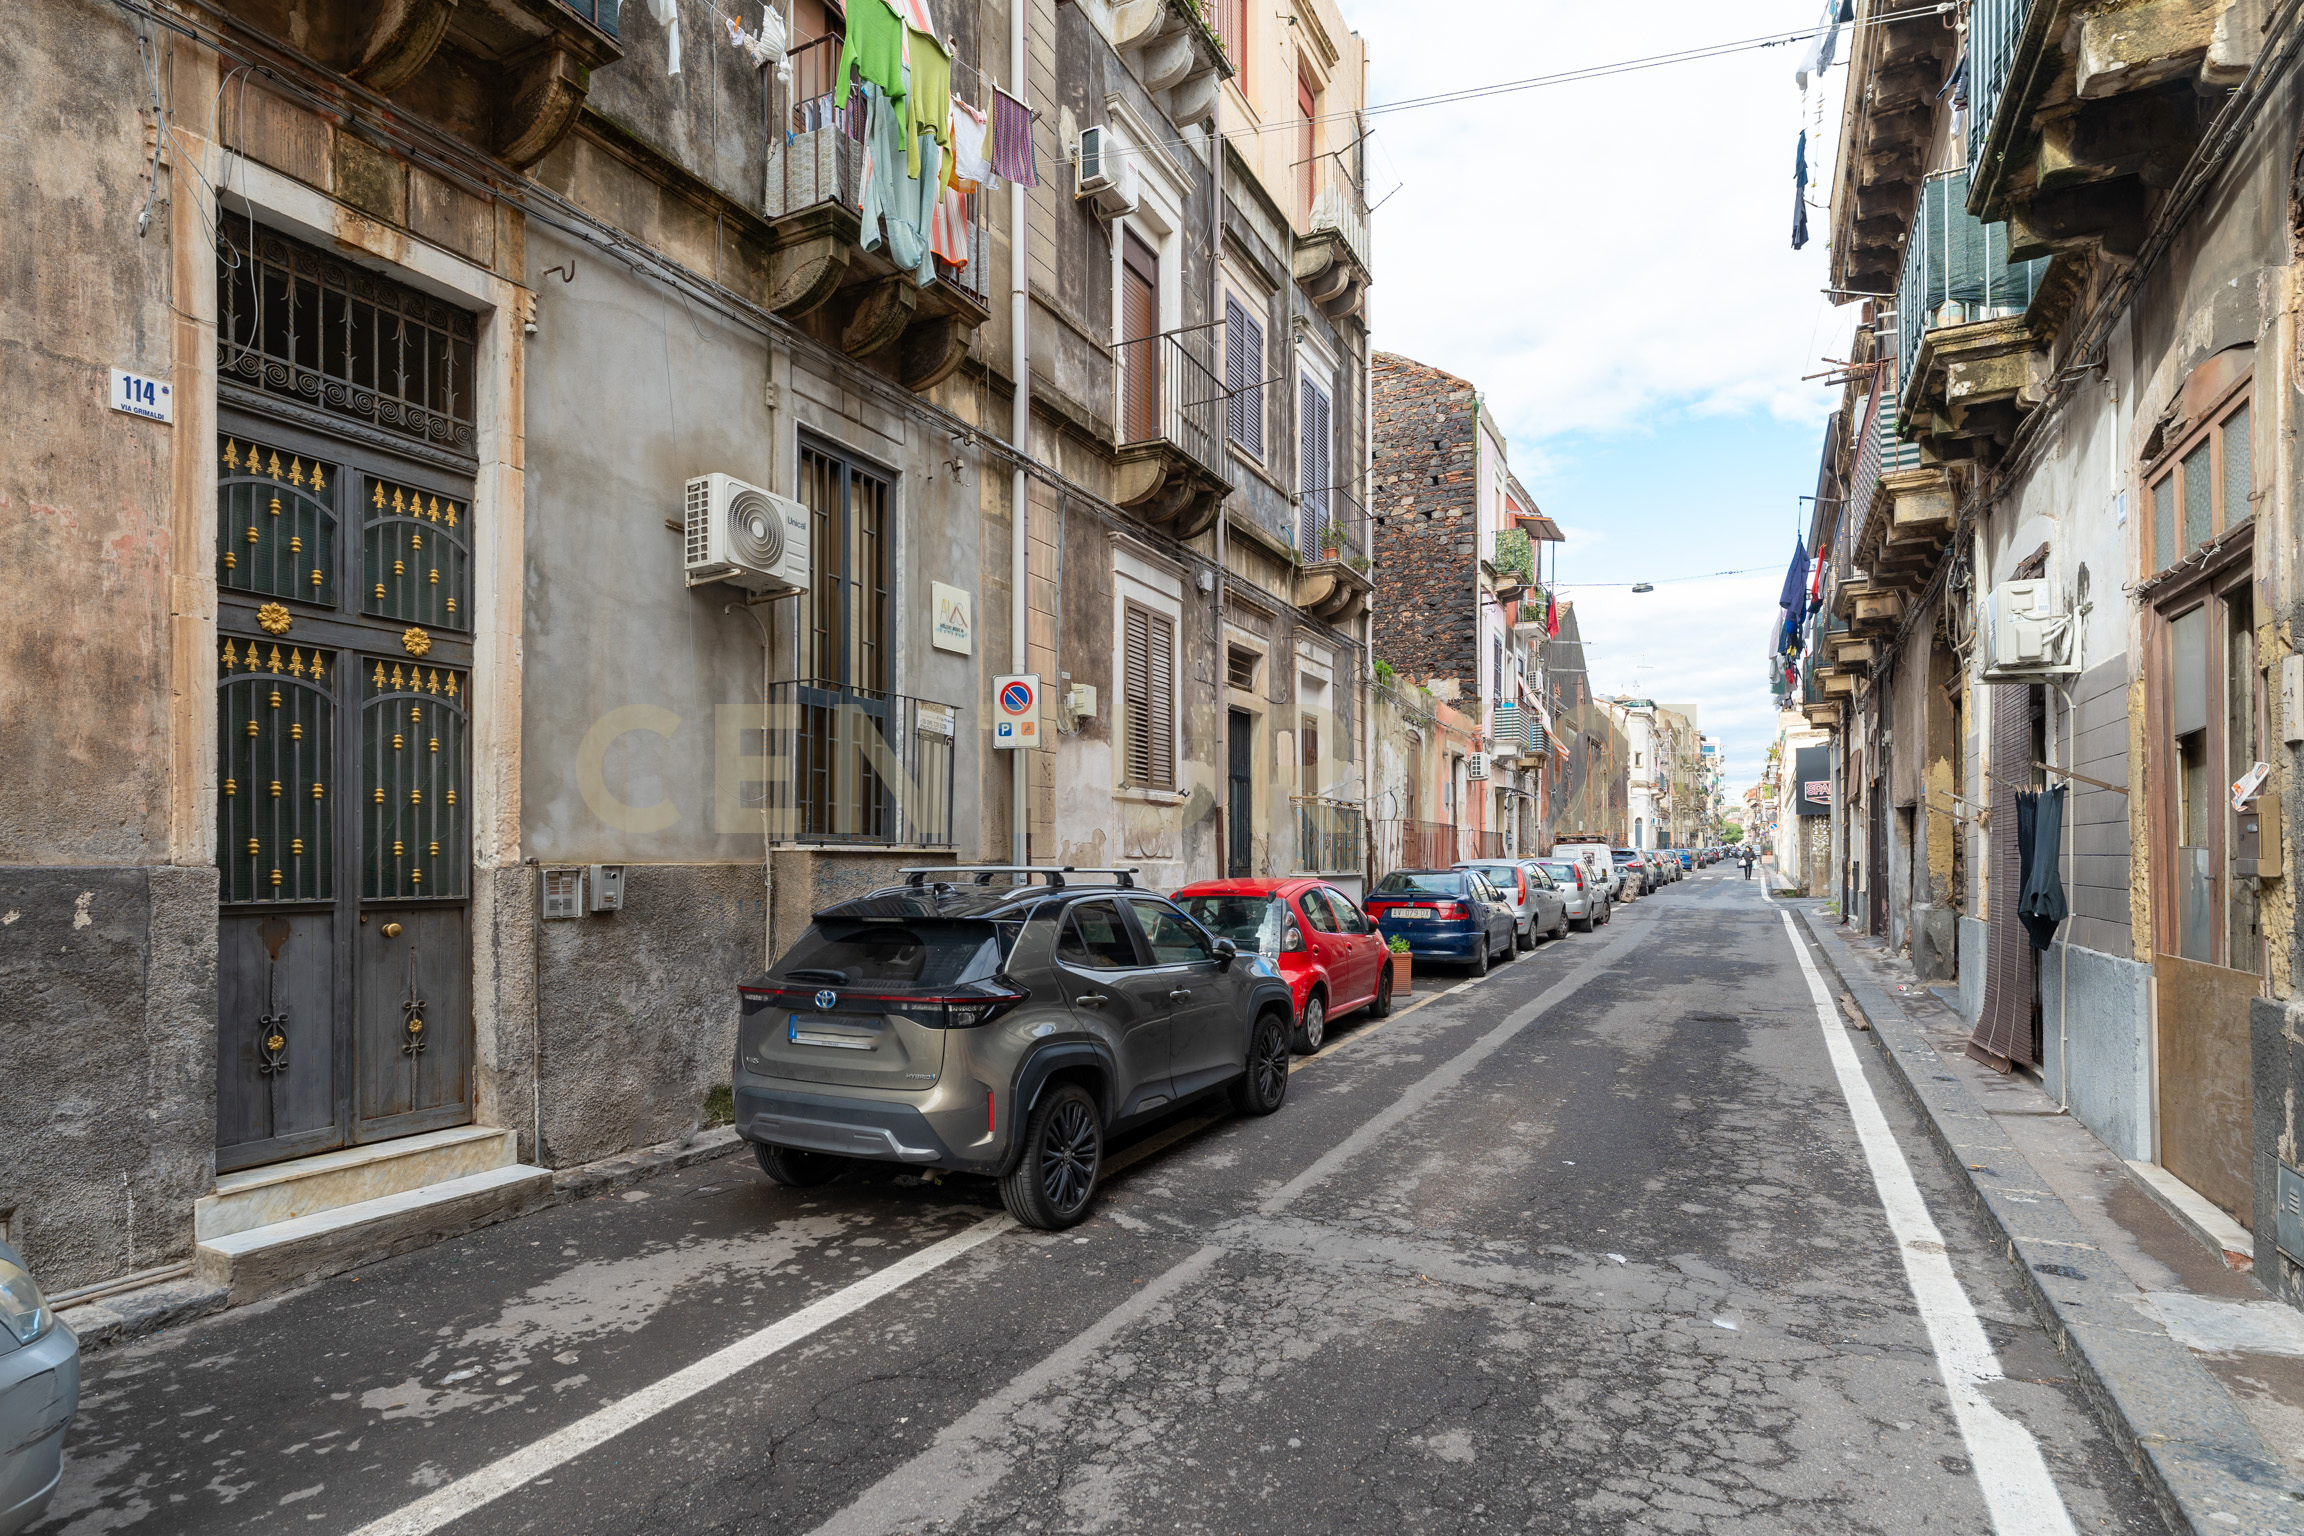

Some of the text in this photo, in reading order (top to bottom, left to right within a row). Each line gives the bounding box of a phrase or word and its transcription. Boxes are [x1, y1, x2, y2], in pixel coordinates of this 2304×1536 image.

[123, 376, 155, 406] 114
[120, 403, 165, 420] VIA GRIMALDI
[787, 515, 807, 531] Unical
[1001, 724, 1010, 735] P
[1405, 909, 1418, 917] 079
